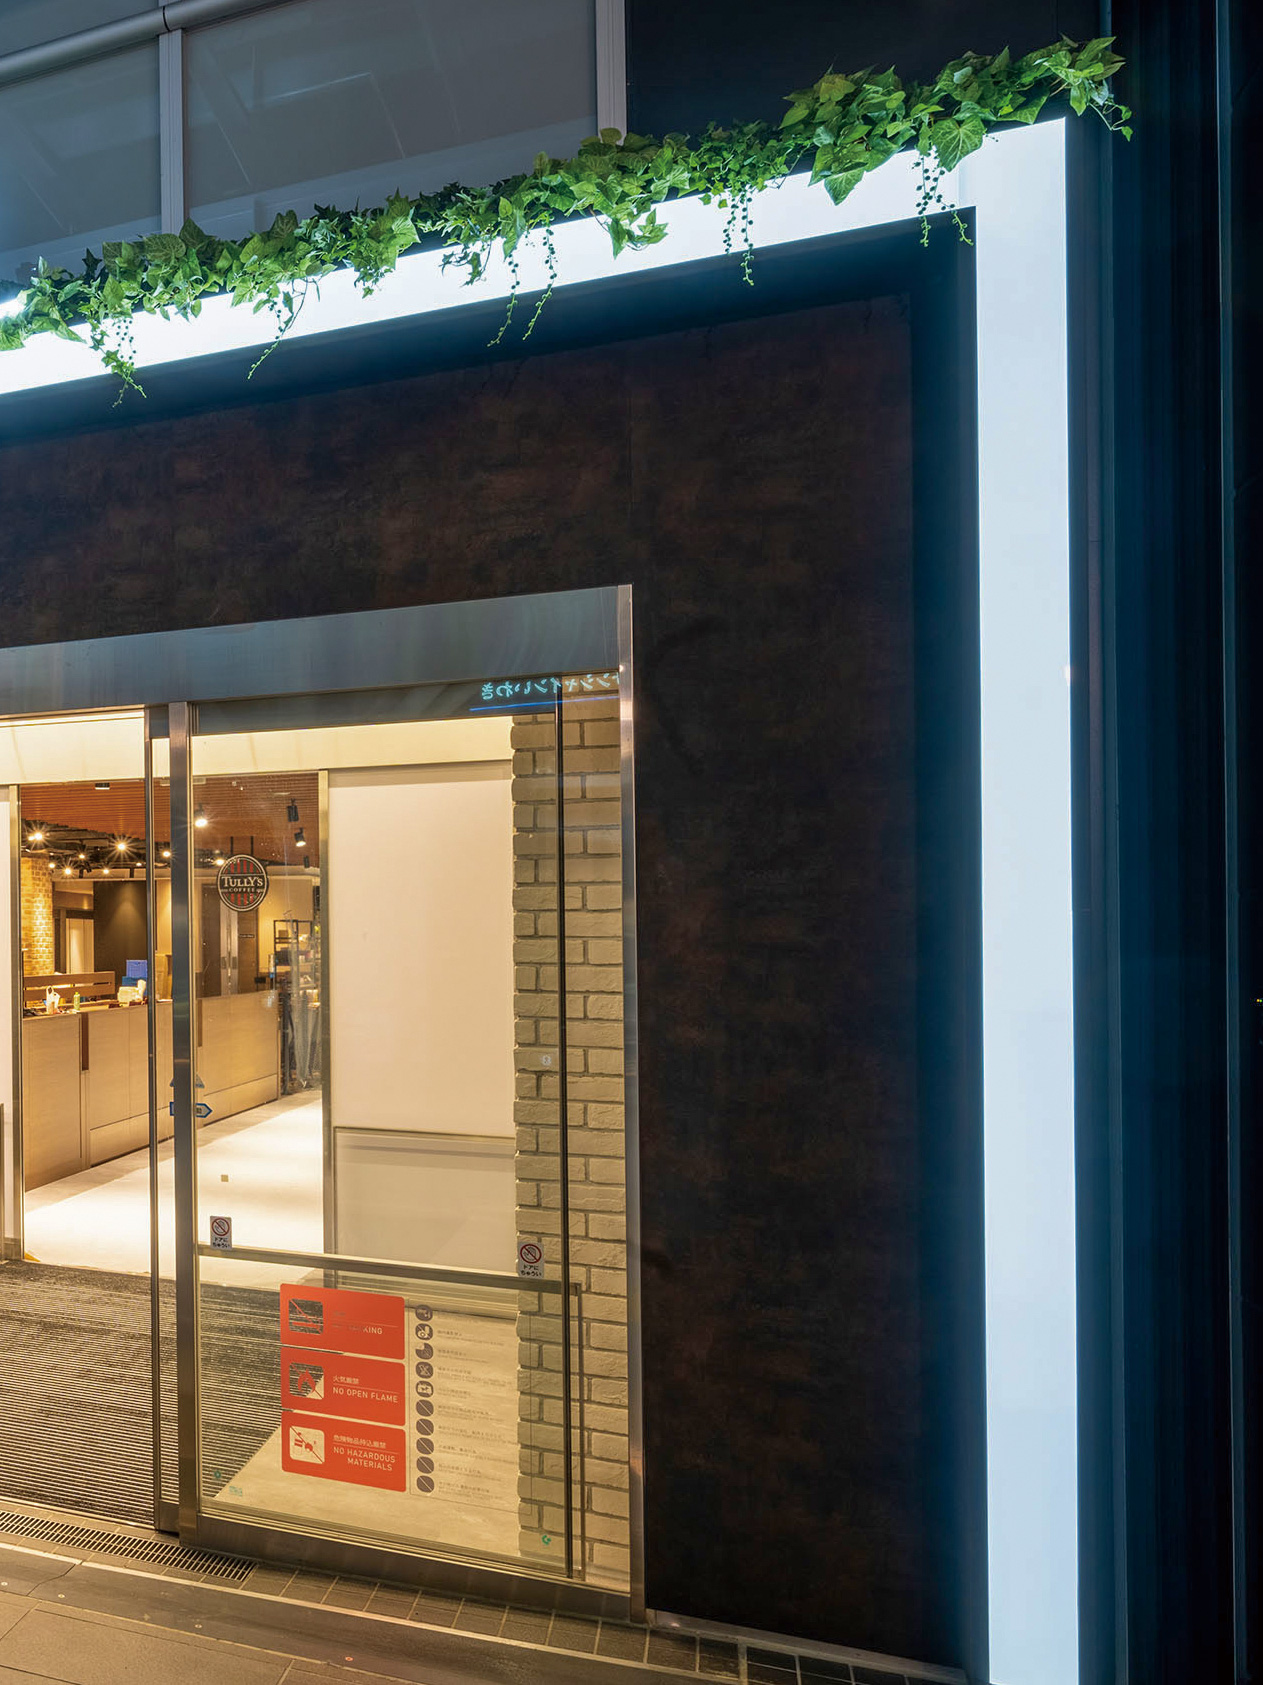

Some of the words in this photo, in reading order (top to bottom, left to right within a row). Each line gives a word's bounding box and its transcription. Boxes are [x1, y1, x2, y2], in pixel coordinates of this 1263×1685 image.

[332, 1387, 344, 1395] NO
[347, 1388, 368, 1399] OPEN
[371, 1392, 398, 1403] FLAME
[333, 1446, 345, 1455] NO
[347, 1448, 396, 1464] HAZARDOUS
[347, 1457, 393, 1472] MATERIALS
